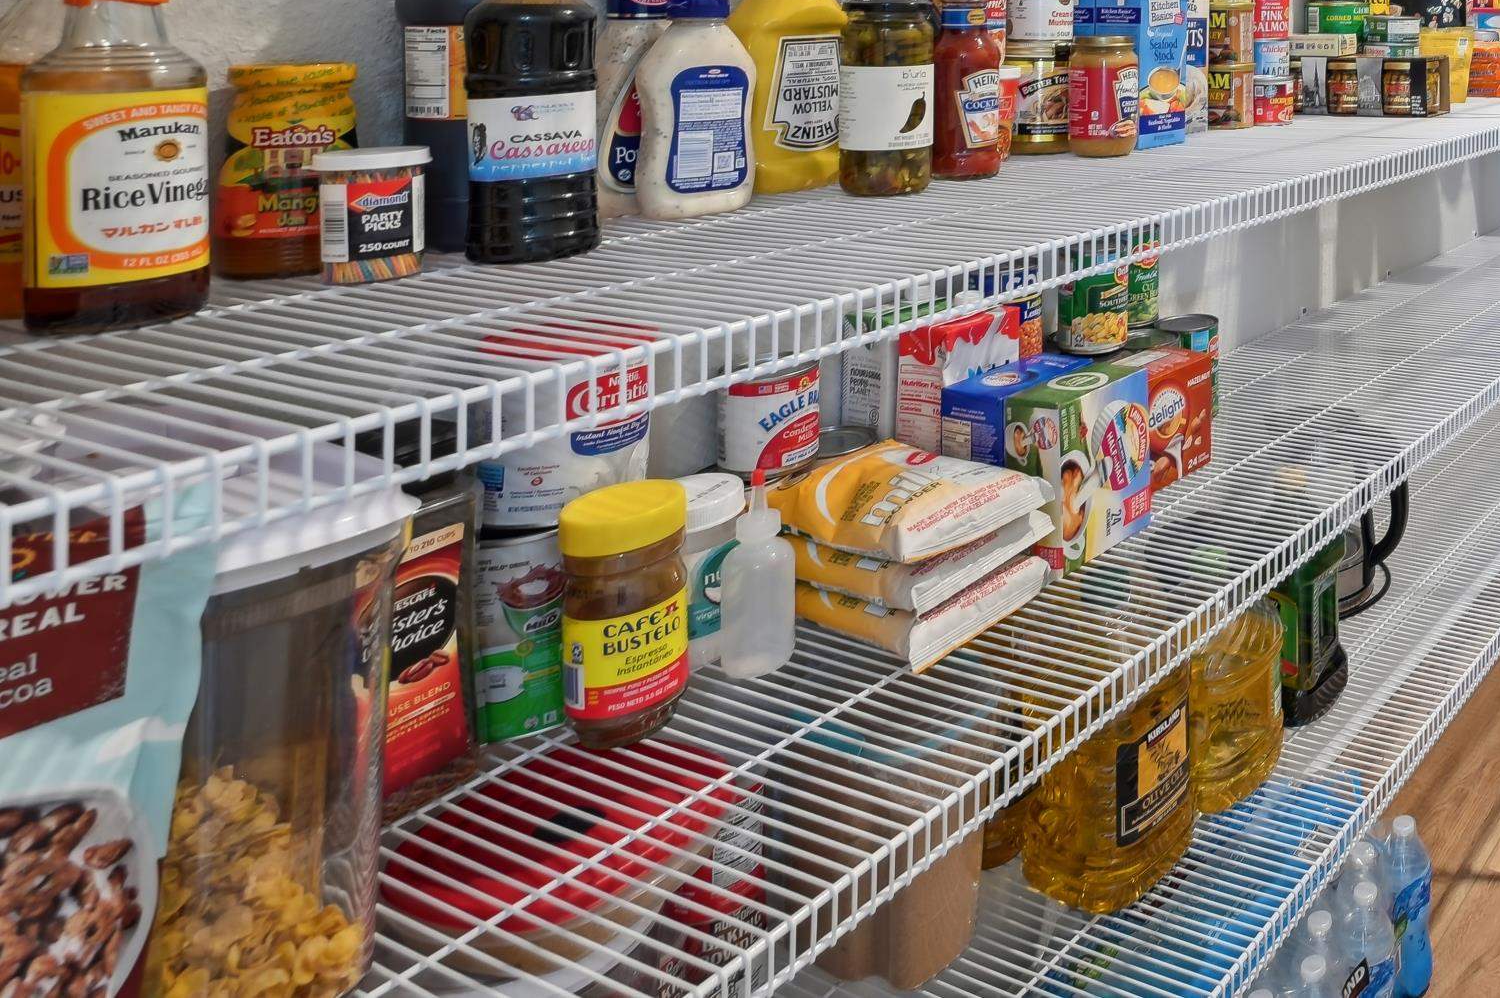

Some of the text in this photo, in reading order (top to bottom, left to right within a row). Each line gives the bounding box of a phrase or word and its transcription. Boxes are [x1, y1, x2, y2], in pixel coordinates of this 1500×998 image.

[1150, 0, 1180, 12] Kitchen
[1150, 12, 1175, 22] Basics
[1260, 10, 1283, 21] PINK
[1154, 50, 1175, 61] Stock
[783, 84, 840, 102] MUSTARD
[792, 100, 833, 116] YELLOW
[83, 110, 127, 130] SWEET
[131, 105, 157, 118] AND
[118, 122, 201, 142] Marukan
[253, 126, 335, 147] Eaton's
[510, 129, 583, 144] CASSAVA
[791, 123, 834, 140] HEINZ
[81, 187, 146, 211] Rice
[362, 191, 410, 206] diamond
[361, 210, 405, 224] PARTY
[101, 221, 170, 239] マルカン
[364, 220, 402, 233] PICKS
[359, 239, 410, 253] 250 COUNT
[758, 394, 805, 432] EAGLE
[1150, 398, 1185, 428] delight
[1106, 431, 1125, 484] HALF HALF
[1187, 458, 1198, 469] 24
[1110, 508, 1122, 527] 24
[420, 537, 435, 550] 210
[436, 530, 456, 543] CUPS
[602, 616, 682, 657] BUSTELO
[624, 643, 668, 666] Espresso
[389, 681, 450, 716] USE BLEND
[1147, 709, 1181, 743] KIRKLAND
[1142, 781, 1170, 809] OLIVE
